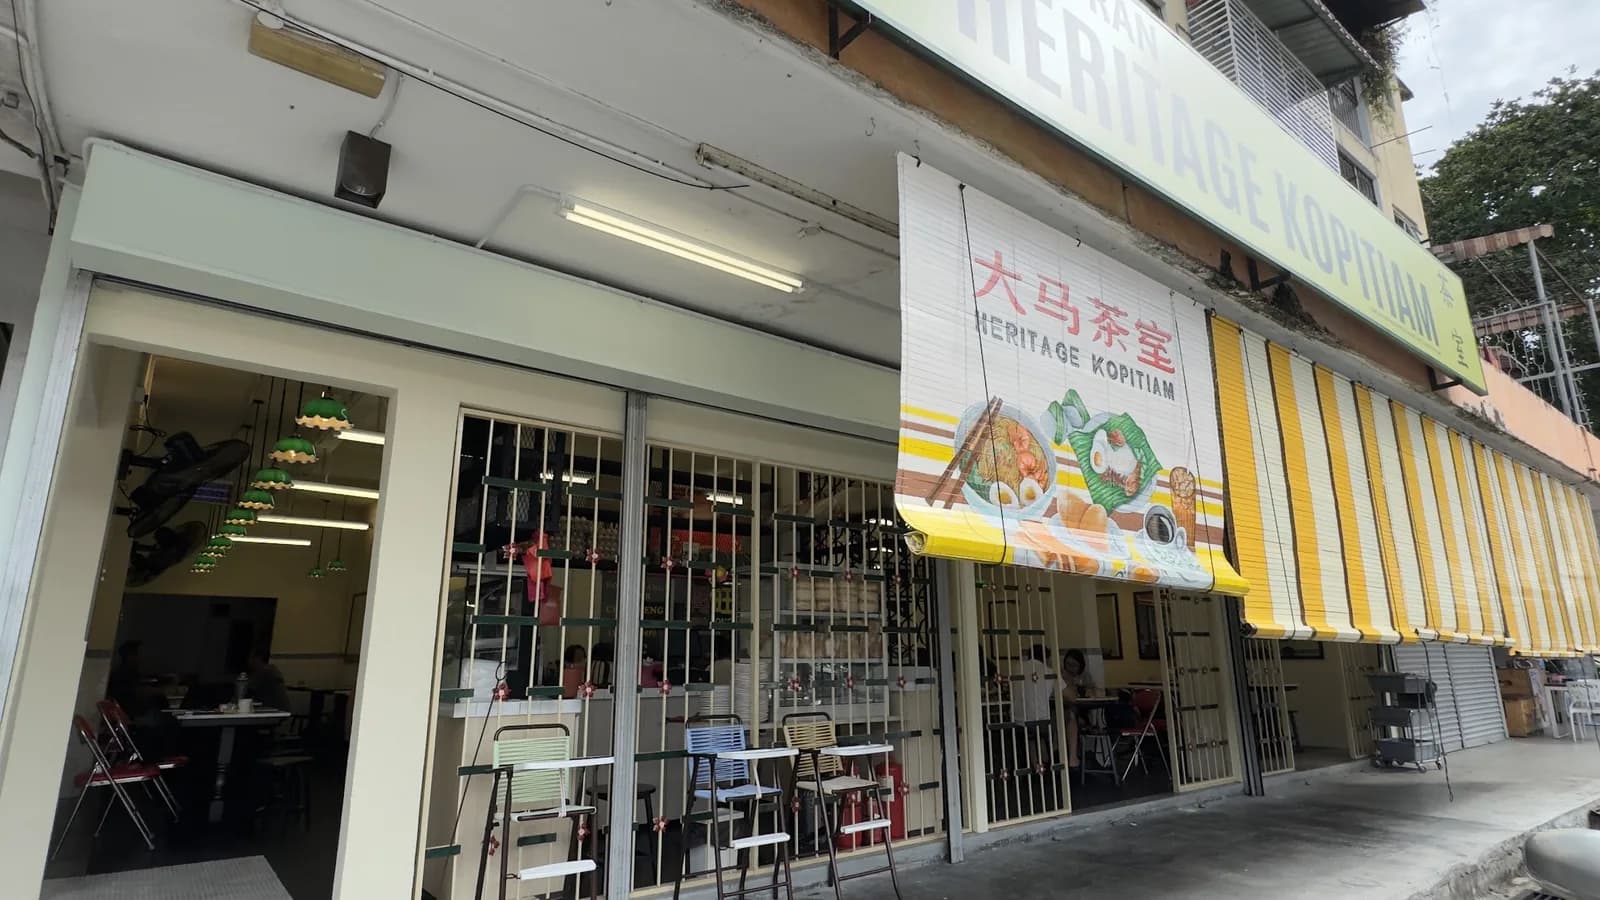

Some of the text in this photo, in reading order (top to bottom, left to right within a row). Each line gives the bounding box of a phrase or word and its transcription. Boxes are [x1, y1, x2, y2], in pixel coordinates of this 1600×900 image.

[973, 249, 1176, 374] 大马茶室
[1273, 168, 1440, 347] KOPITIAM
[976, 310, 1176, 401] HERITAGE KOPITIAM
